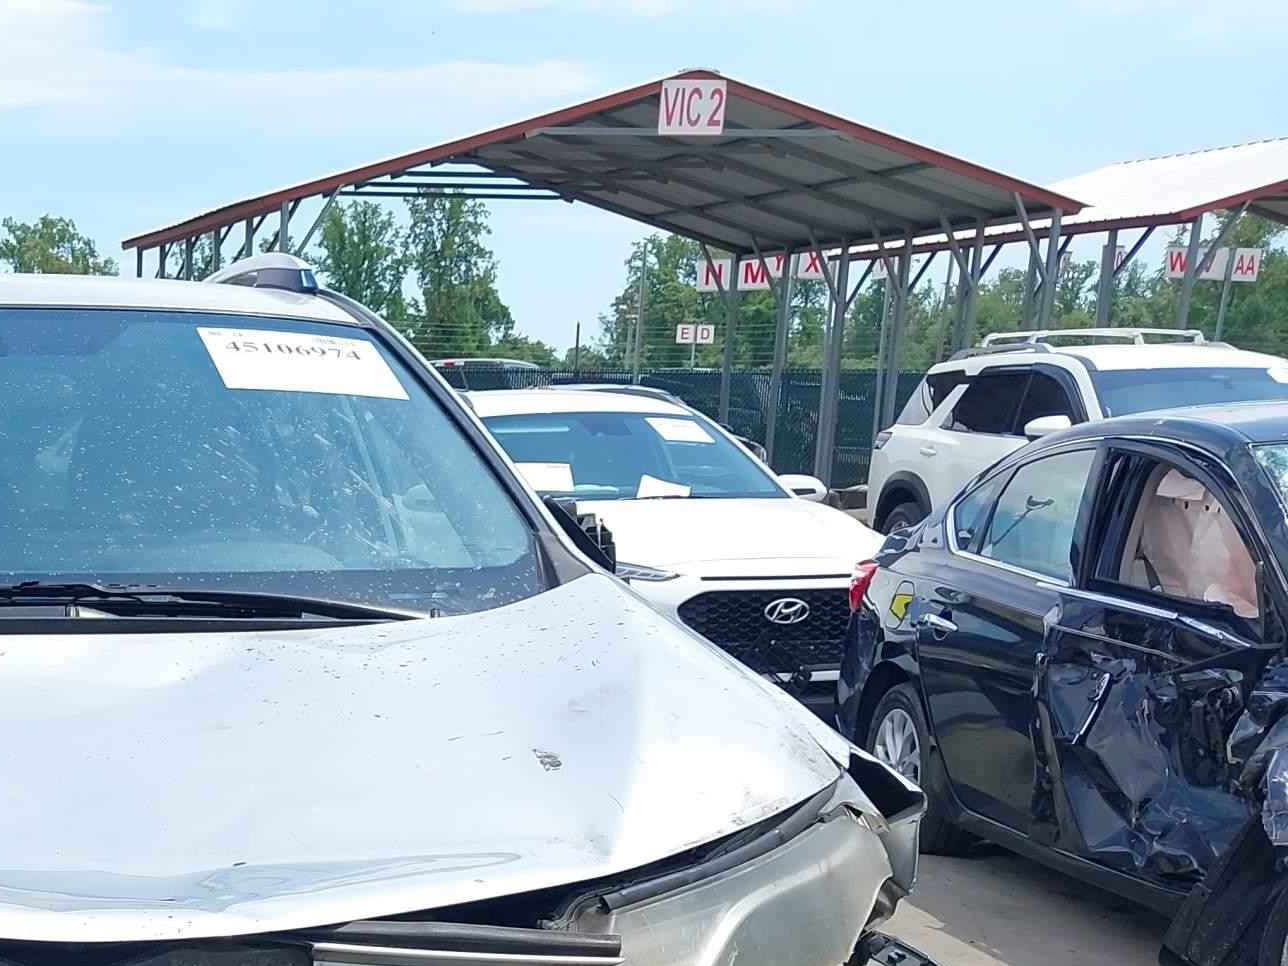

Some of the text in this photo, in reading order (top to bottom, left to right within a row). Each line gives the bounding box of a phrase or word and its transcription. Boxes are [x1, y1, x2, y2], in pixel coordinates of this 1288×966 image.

[664, 87, 723, 127] VIC 2
[805, 250, 819, 272] X
[1234, 254, 1255, 275] AA
[705, 263, 723, 286] N
[744, 262, 765, 284] M
[681, 327, 689, 340] E
[701, 327, 711, 340] D
[225, 340, 361, 360] 45106974
